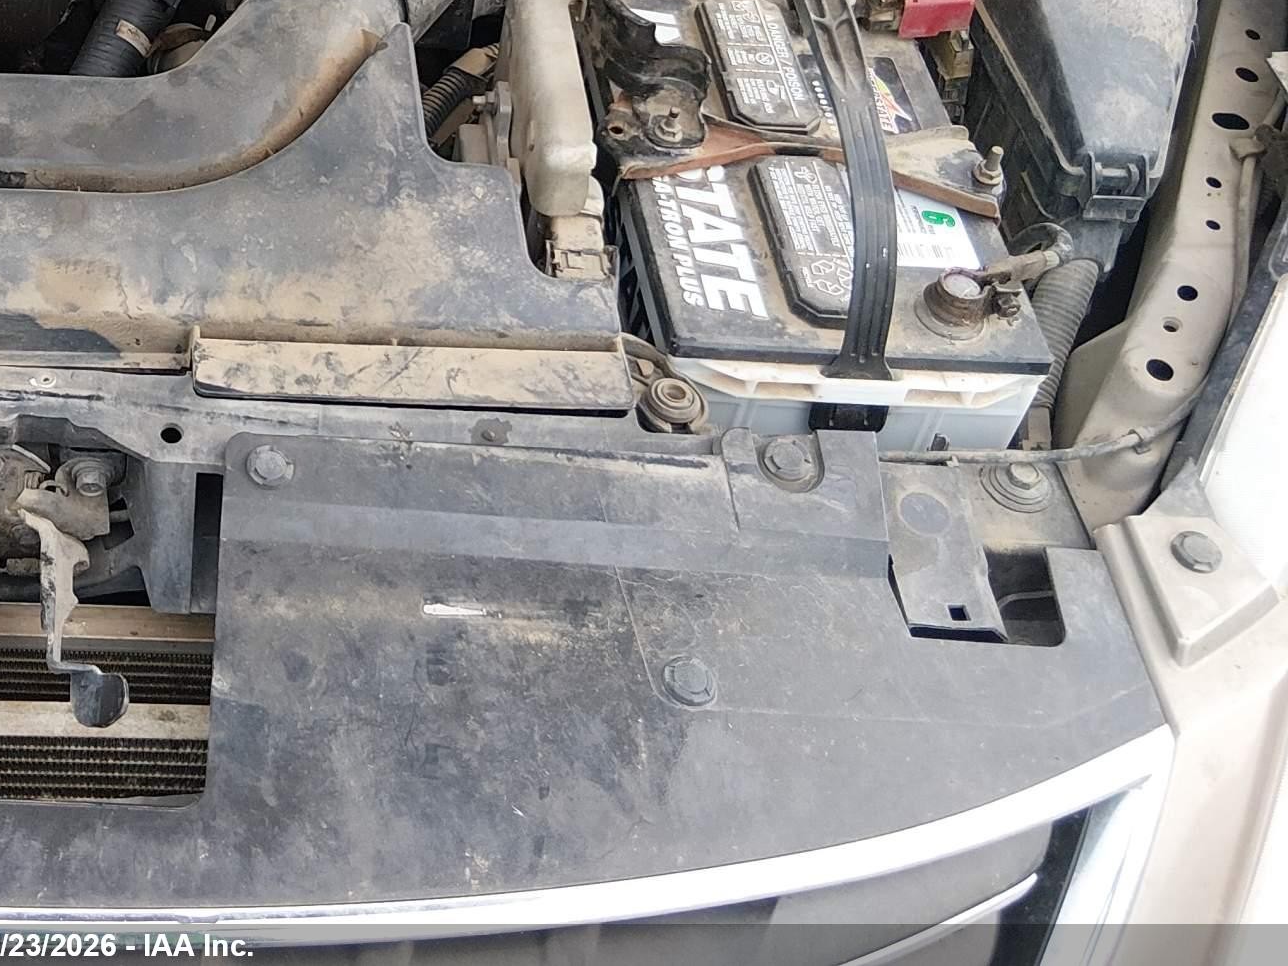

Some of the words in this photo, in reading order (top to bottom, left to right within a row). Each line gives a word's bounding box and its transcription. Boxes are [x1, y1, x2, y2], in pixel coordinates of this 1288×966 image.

[768, 23, 789, 58] DANGER
[782, 67, 804, 101] POISON
[921, 210, 956, 227] 6
[674, 253, 705, 307] PLUS
